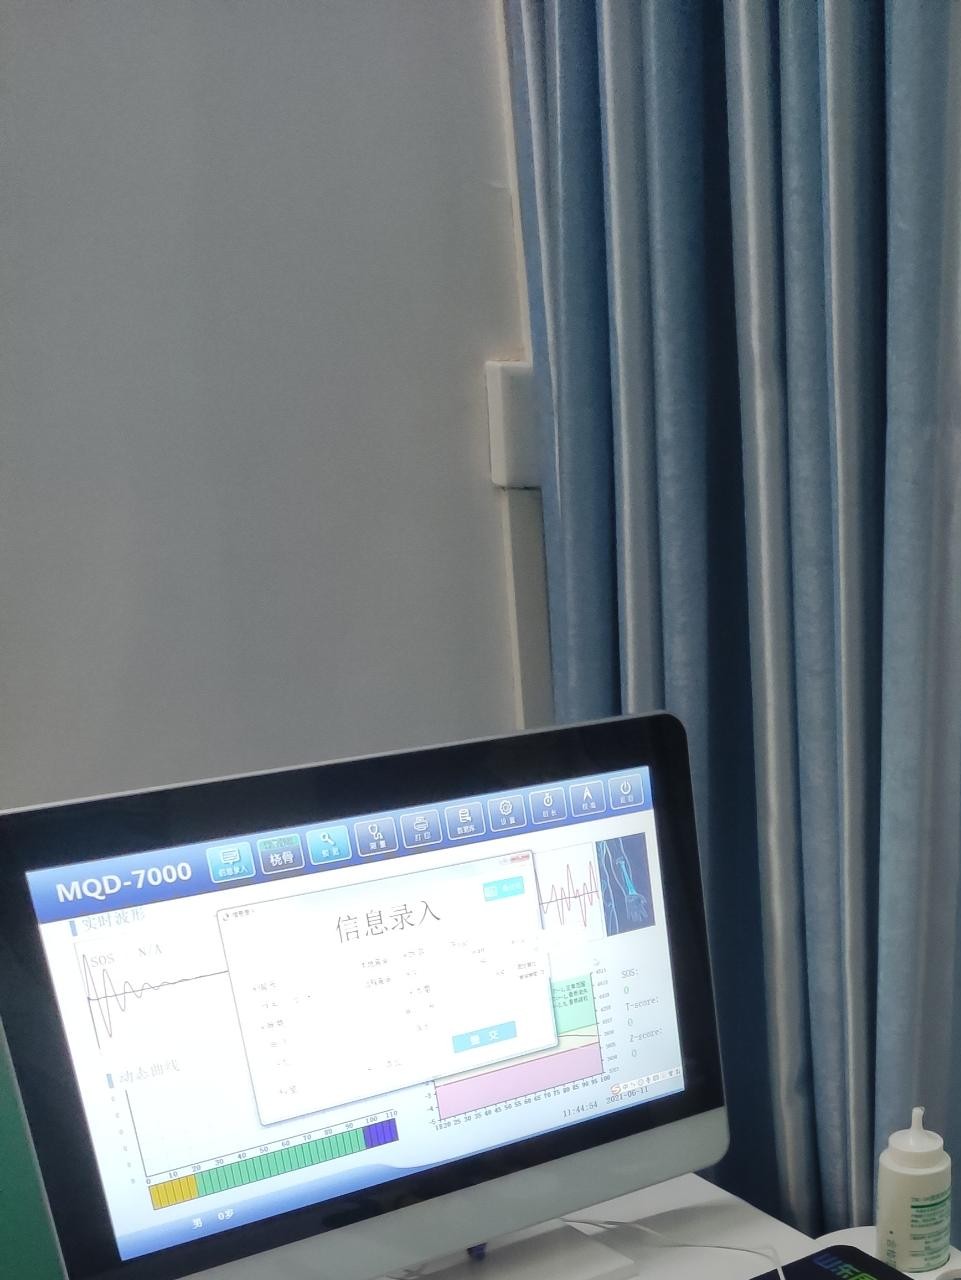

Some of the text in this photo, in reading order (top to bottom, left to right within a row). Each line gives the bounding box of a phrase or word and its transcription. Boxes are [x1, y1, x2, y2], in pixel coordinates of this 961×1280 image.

[56, 862, 192, 903] MQD-7000
[336, 900, 441, 943] 信息录入
[90, 954, 116, 968] SOS
[625, 996, 660, 1011] T-score:
[168, 1171, 178, 1179] 10
[191, 1165, 202, 1173] 20
[259, 1146, 269, 1154] 50
[385, 1110, 398, 1118] 110
